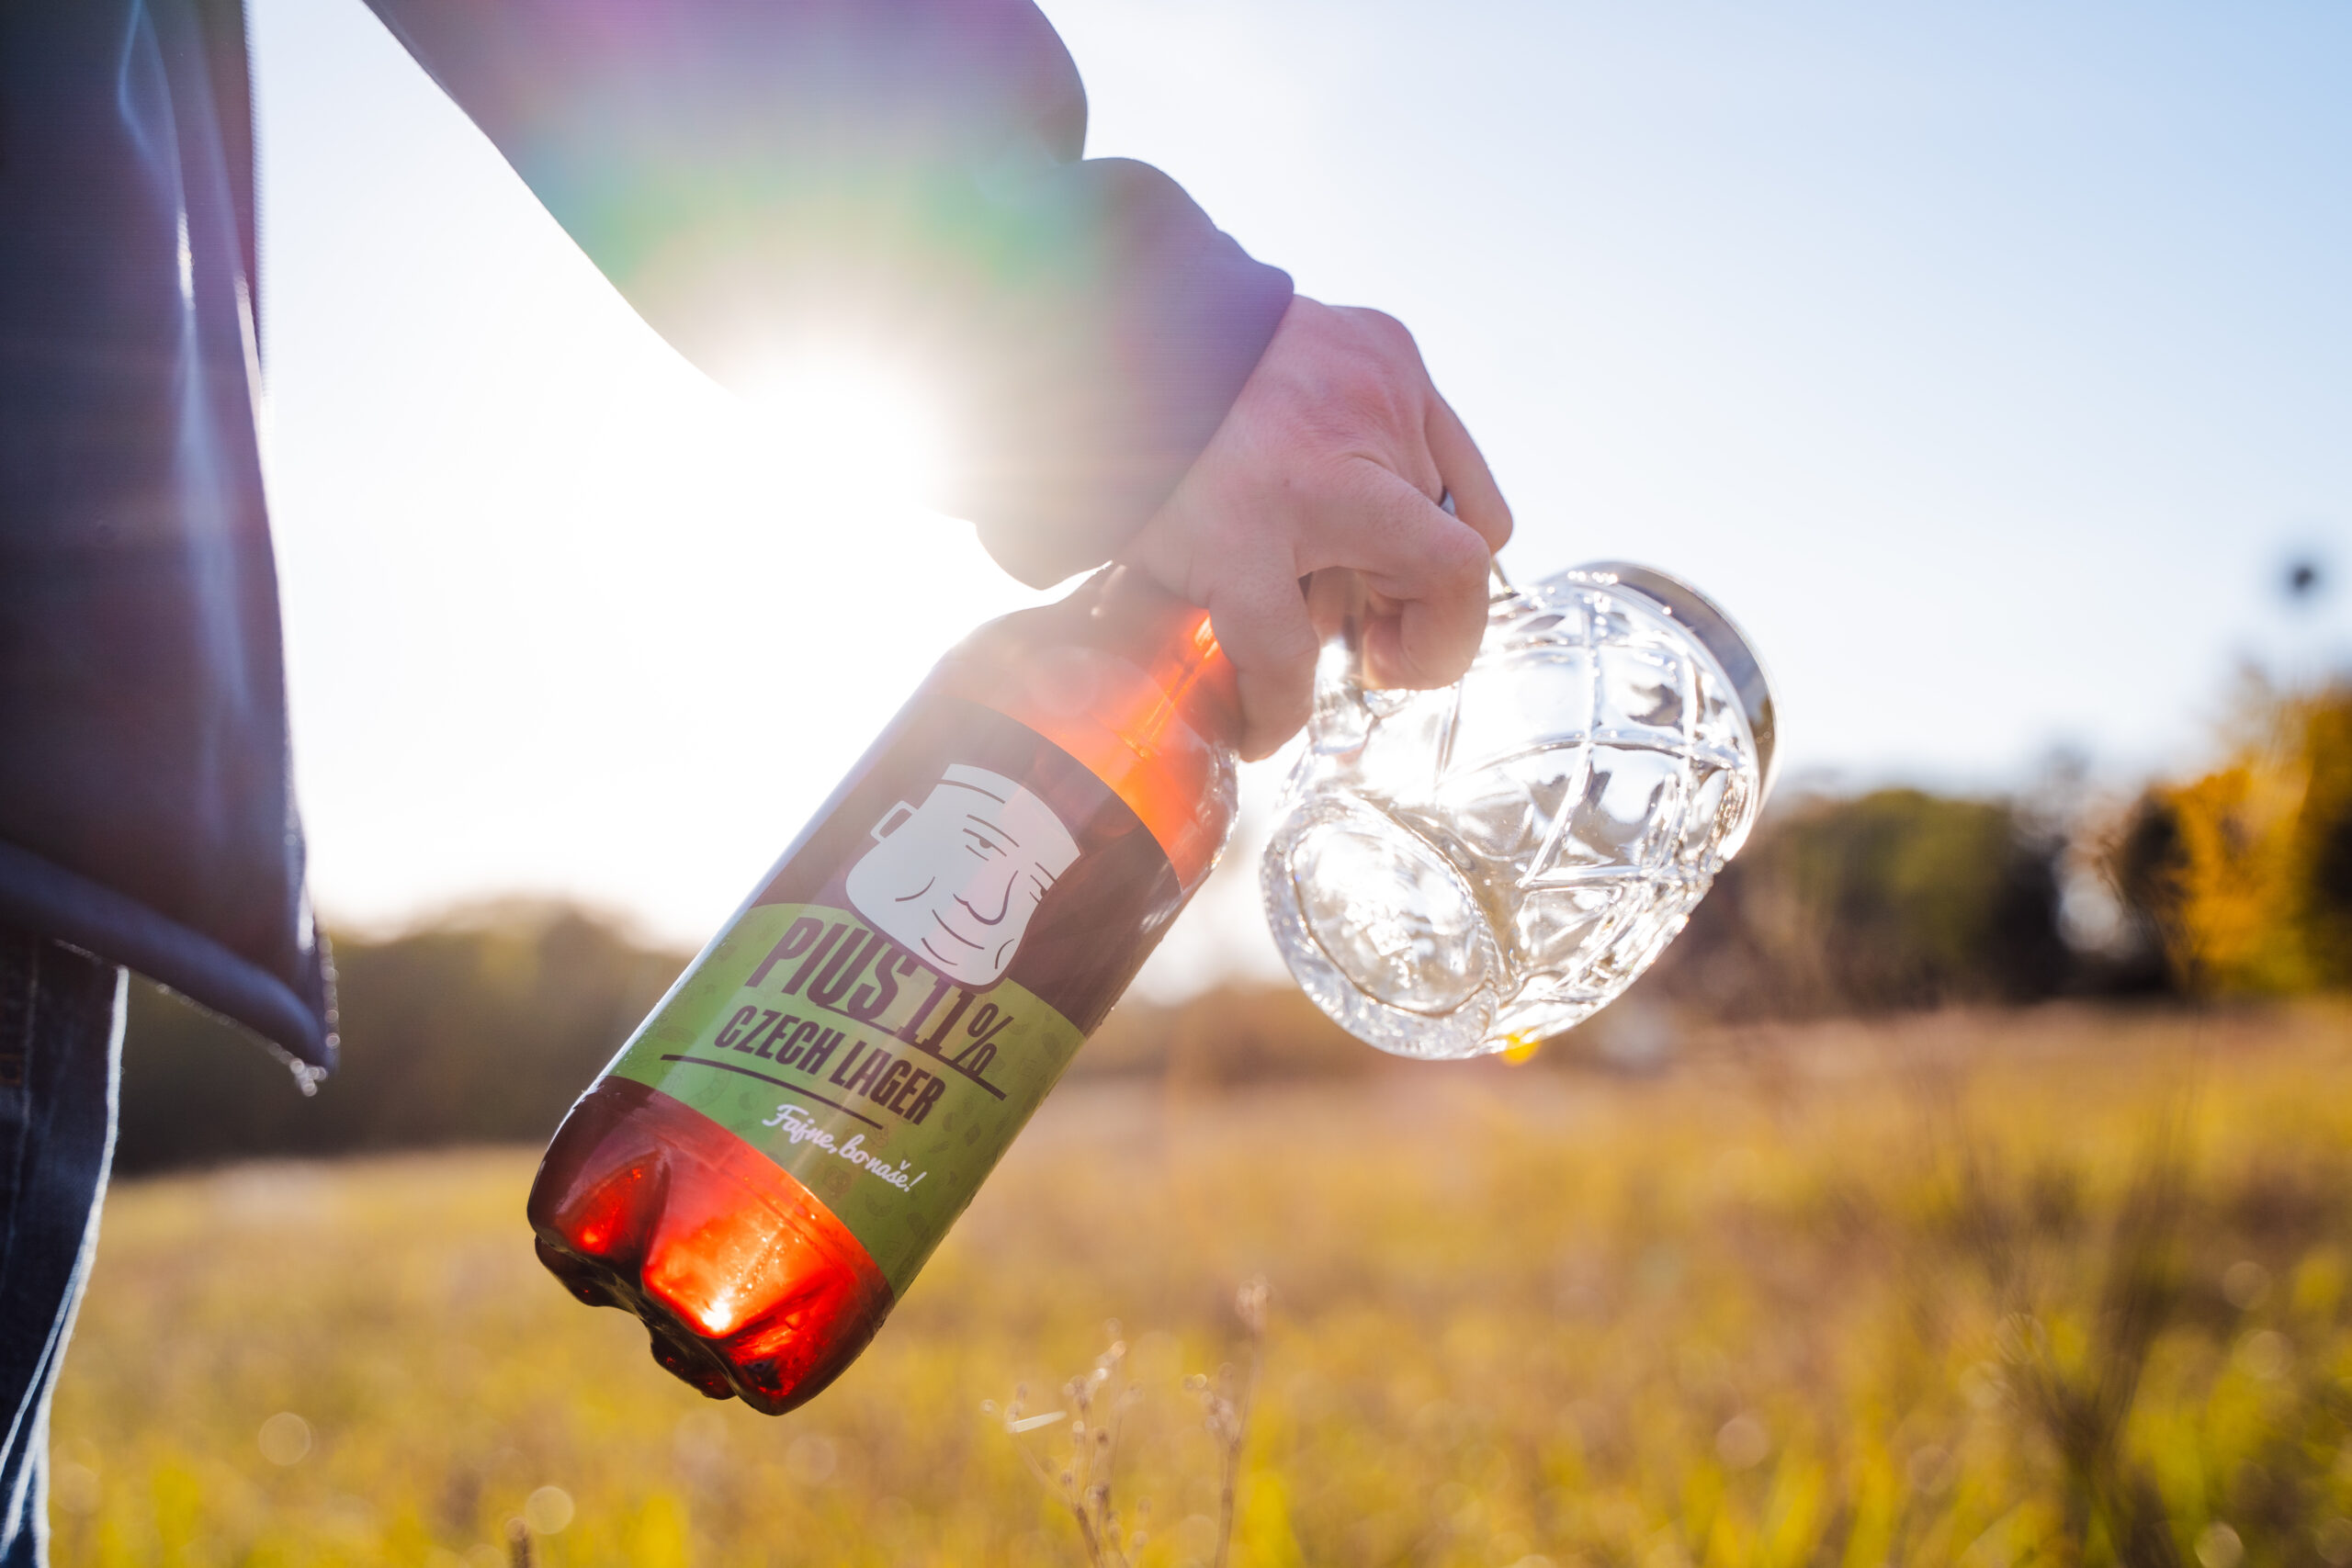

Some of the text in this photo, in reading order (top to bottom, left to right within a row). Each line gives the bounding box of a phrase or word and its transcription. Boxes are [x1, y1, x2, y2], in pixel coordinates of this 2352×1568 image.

[744, 917, 1015, 1079] PIUS 11%
[714, 1005, 946, 1126] CZECH LAGER
[762, 1104, 837, 1154] Fajne,
